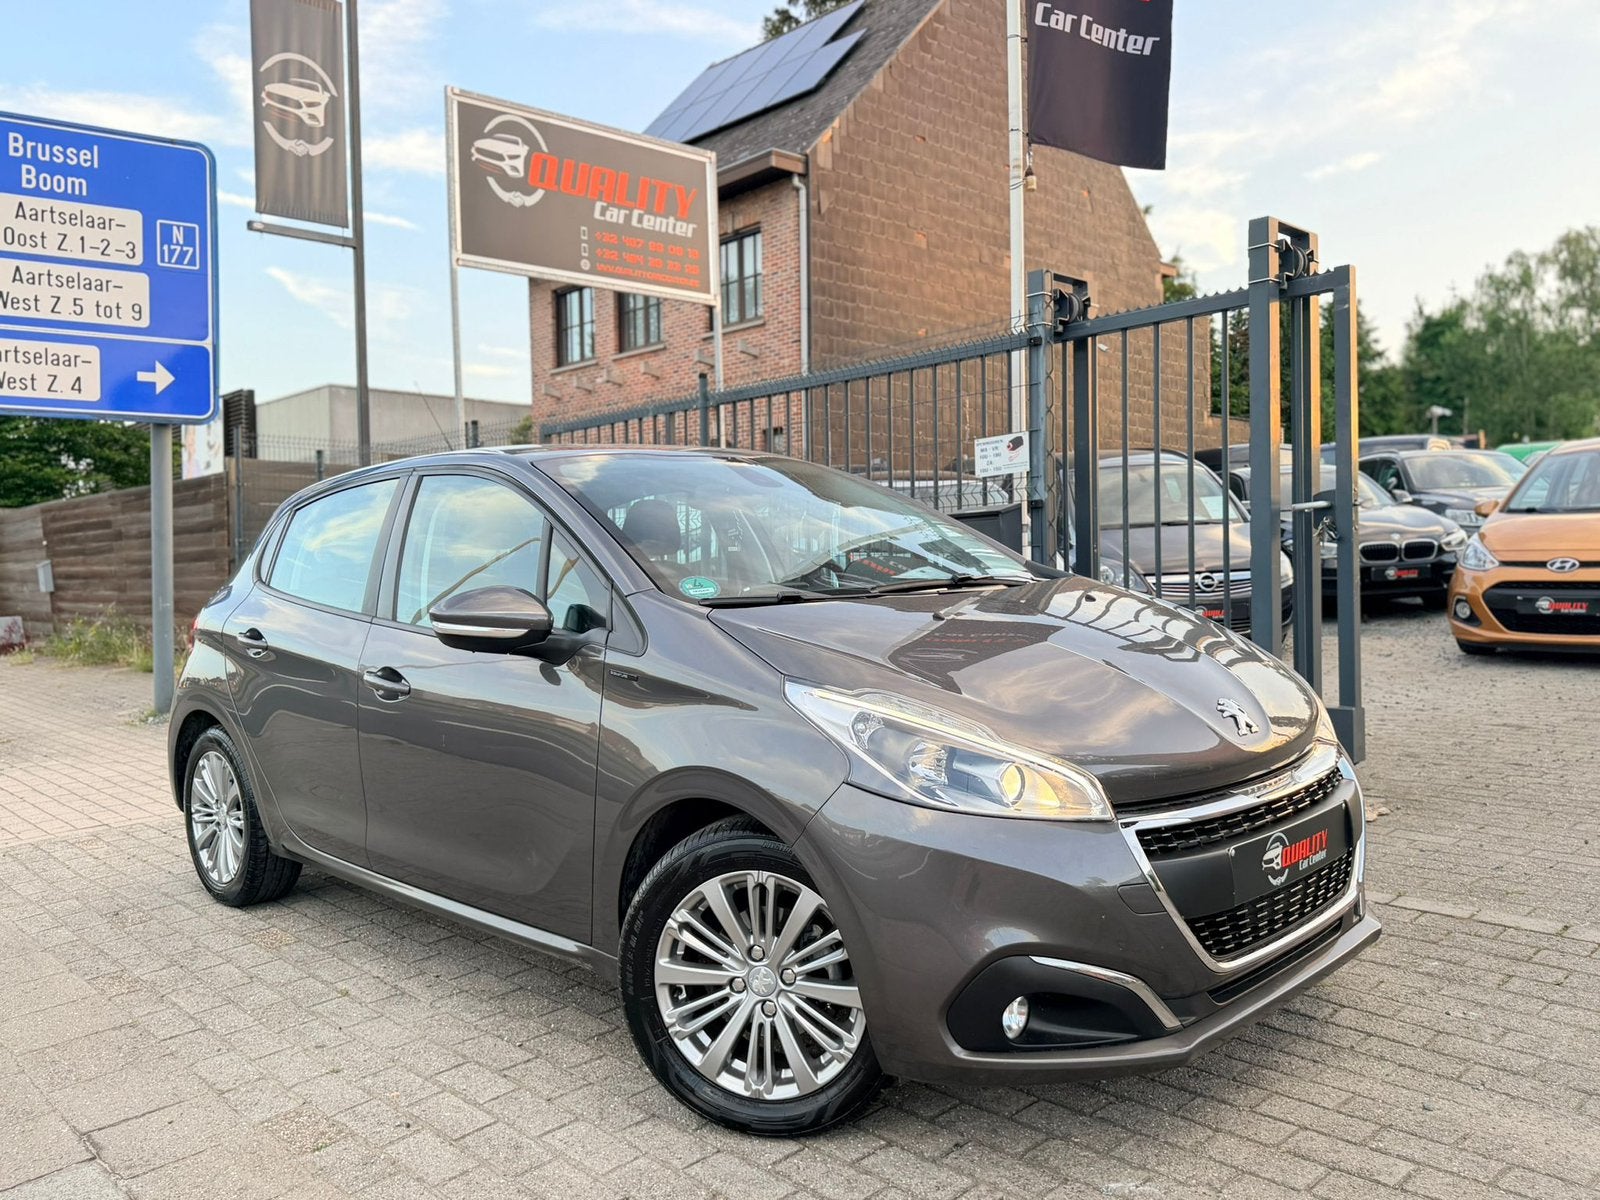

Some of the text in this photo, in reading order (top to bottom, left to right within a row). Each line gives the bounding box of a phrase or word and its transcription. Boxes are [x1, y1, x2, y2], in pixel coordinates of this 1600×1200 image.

[1034, 2, 1160, 56] Car Center
[8, 131, 99, 169] Brussel
[21, 163, 87, 196] Boom
[528, 152, 697, 220] QUALITY
[15, 201, 126, 231] Aartselaar-
[593, 201, 698, 238] Car Center
[3, 226, 47, 250] Oost
[172, 225, 184, 245] N
[162, 245, 194, 265] 177
[11, 265, 123, 292] Aartselaar-
[95, 300, 122, 319] tot
[131, 303, 143, 321] 9
[71, 376, 82, 395] 4
[1281, 828, 1328, 868] QUALITY
[1299, 857, 1309, 871] Car
